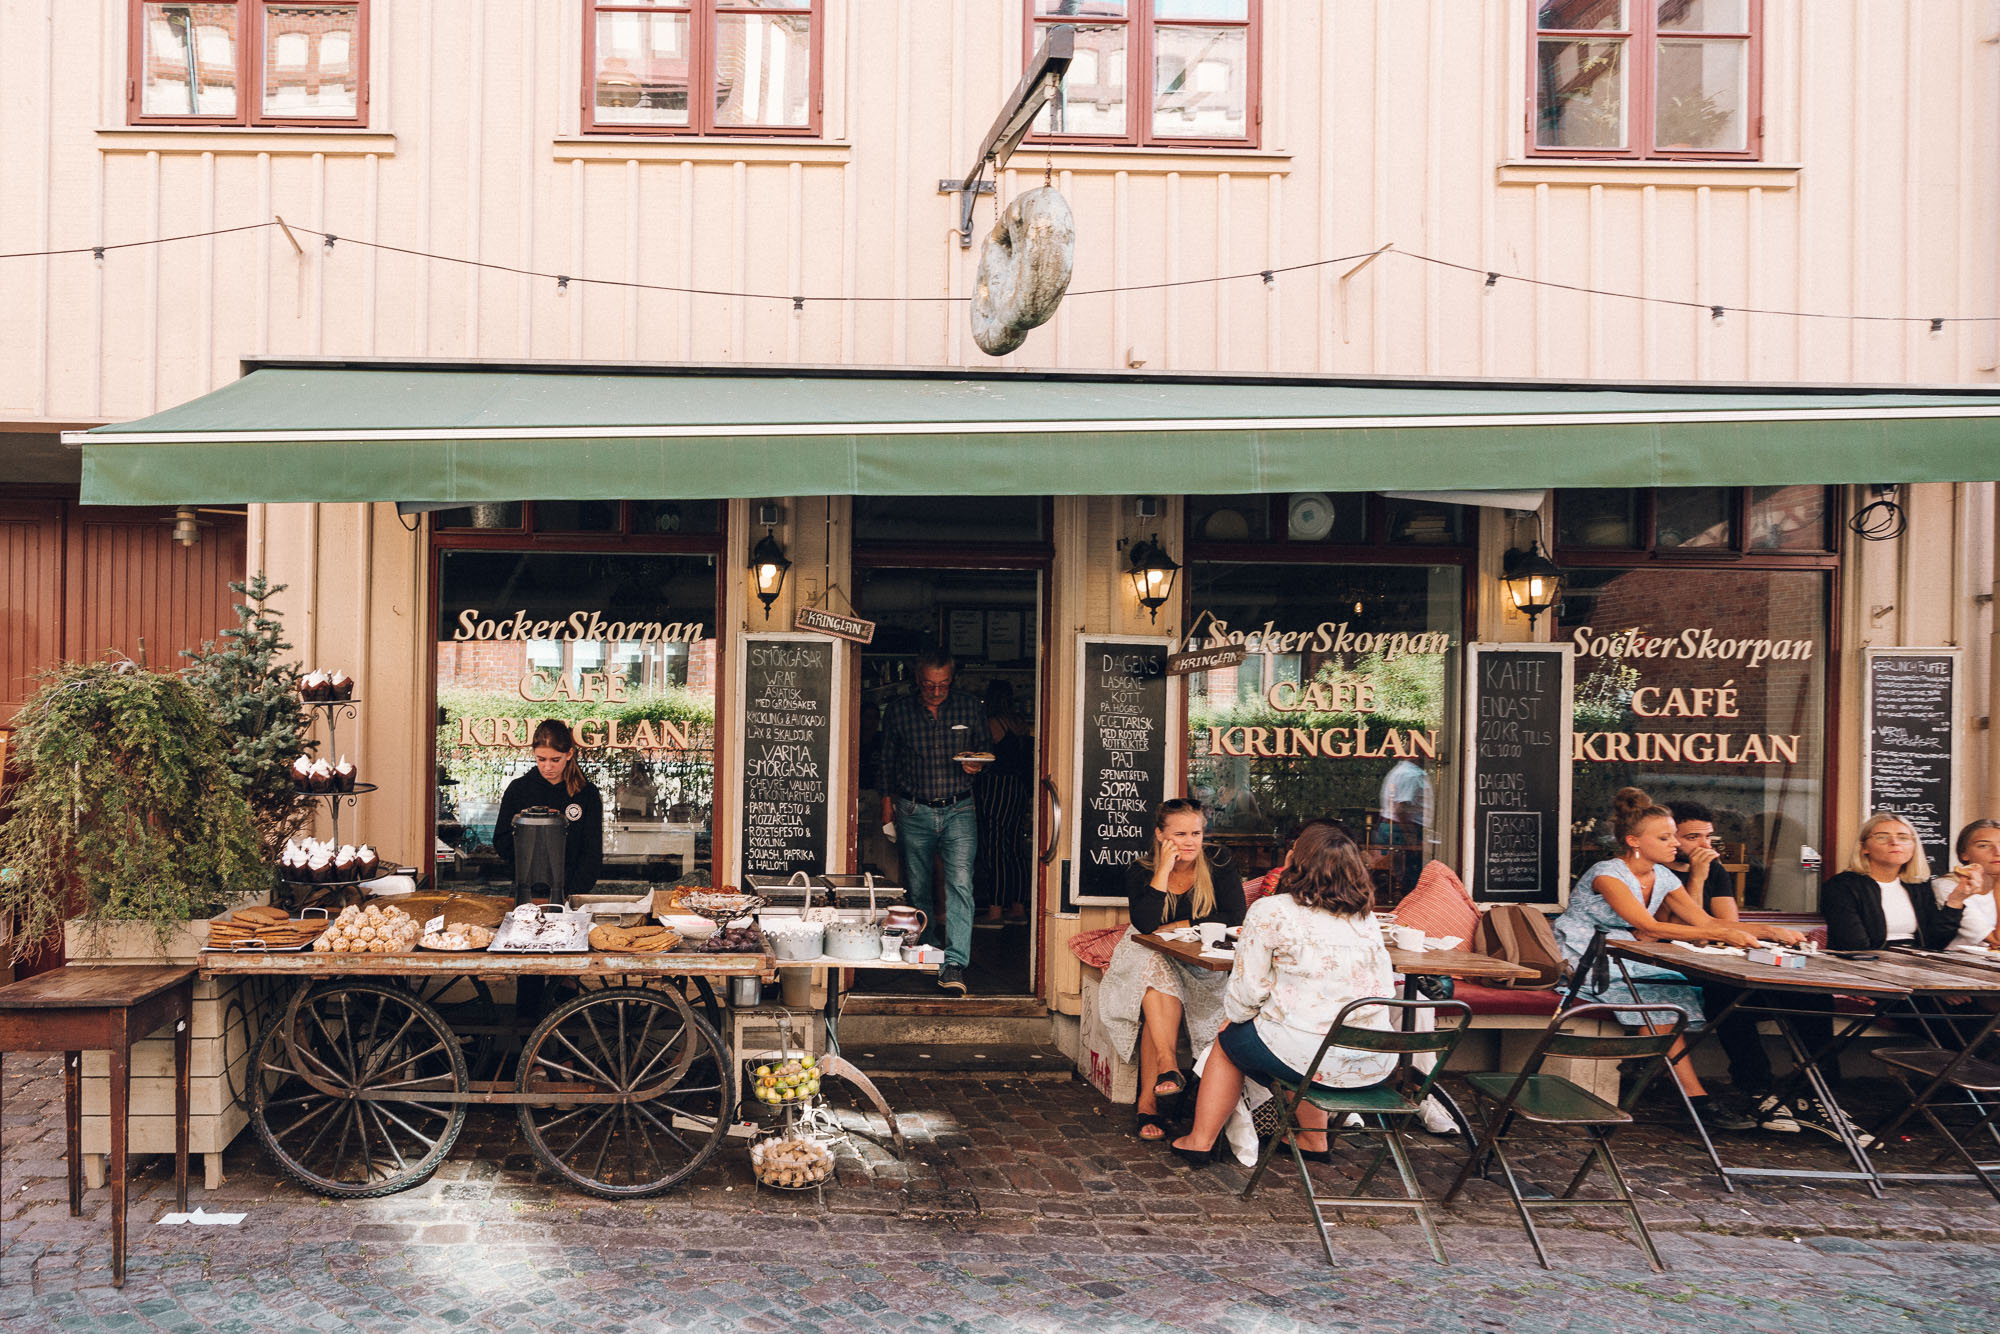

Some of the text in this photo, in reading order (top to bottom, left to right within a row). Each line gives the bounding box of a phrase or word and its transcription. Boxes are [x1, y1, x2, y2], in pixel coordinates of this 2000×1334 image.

[453, 609, 704, 650] SockerSkorpan
[807, 611, 862, 635] KRINGLAN
[1203, 620, 1450, 662] SockerSkorpan
[1573, 626, 1813, 668] SockerSkorpan
[1103, 654, 1160, 675] DAGENS
[1179, 651, 1237, 671] KRINGLAN
[519, 664, 629, 703] CAFÉ
[763, 671, 798, 687] WRAP
[1101, 676, 1146, 690] LASAGNE
[1486, 660, 1546, 692] KAFFE
[1268, 674, 1377, 713] CAFÉ
[1631, 679, 1740, 718] CAFÉ
[755, 699, 770, 708] MED
[1100, 700, 1111, 712] PÅ
[1481, 696, 1541, 720] ENDAST
[1093, 714, 1154, 730] VEGETARISK
[457, 716, 692, 749] KRIGLAN
[766, 728, 772, 739] &
[1100, 728, 1149, 740] MED ROSTADE
[1102, 738, 1150, 751] ROTFRUKTER
[1207, 726, 1439, 759] KRINGLAN
[1572, 732, 1800, 764] KRINGLAN
[761, 744, 812, 762] VARMA
[1111, 751, 1134, 769] PAJ
[1099, 781, 1139, 797] SOPPA
[1479, 773, 1524, 791] DAGENS
[750, 789, 756, 799] &
[779, 802, 803, 815] PESTO
[805, 804, 811, 815] &
[1090, 798, 1147, 812] VEGETARISK
[1877, 802, 1939, 814] SALLADER
[749, 814, 803, 826] MOZZARELLA
[1108, 811, 1130, 824] FISK
[1492, 816, 1536, 834] BAKAD
[805, 827, 811, 838] &
[1098, 824, 1143, 838] GULASCH
[749, 837, 786, 847] KYCKLING
[783, 849, 815, 861] PAPRIKA
[747, 860, 754, 870] &
